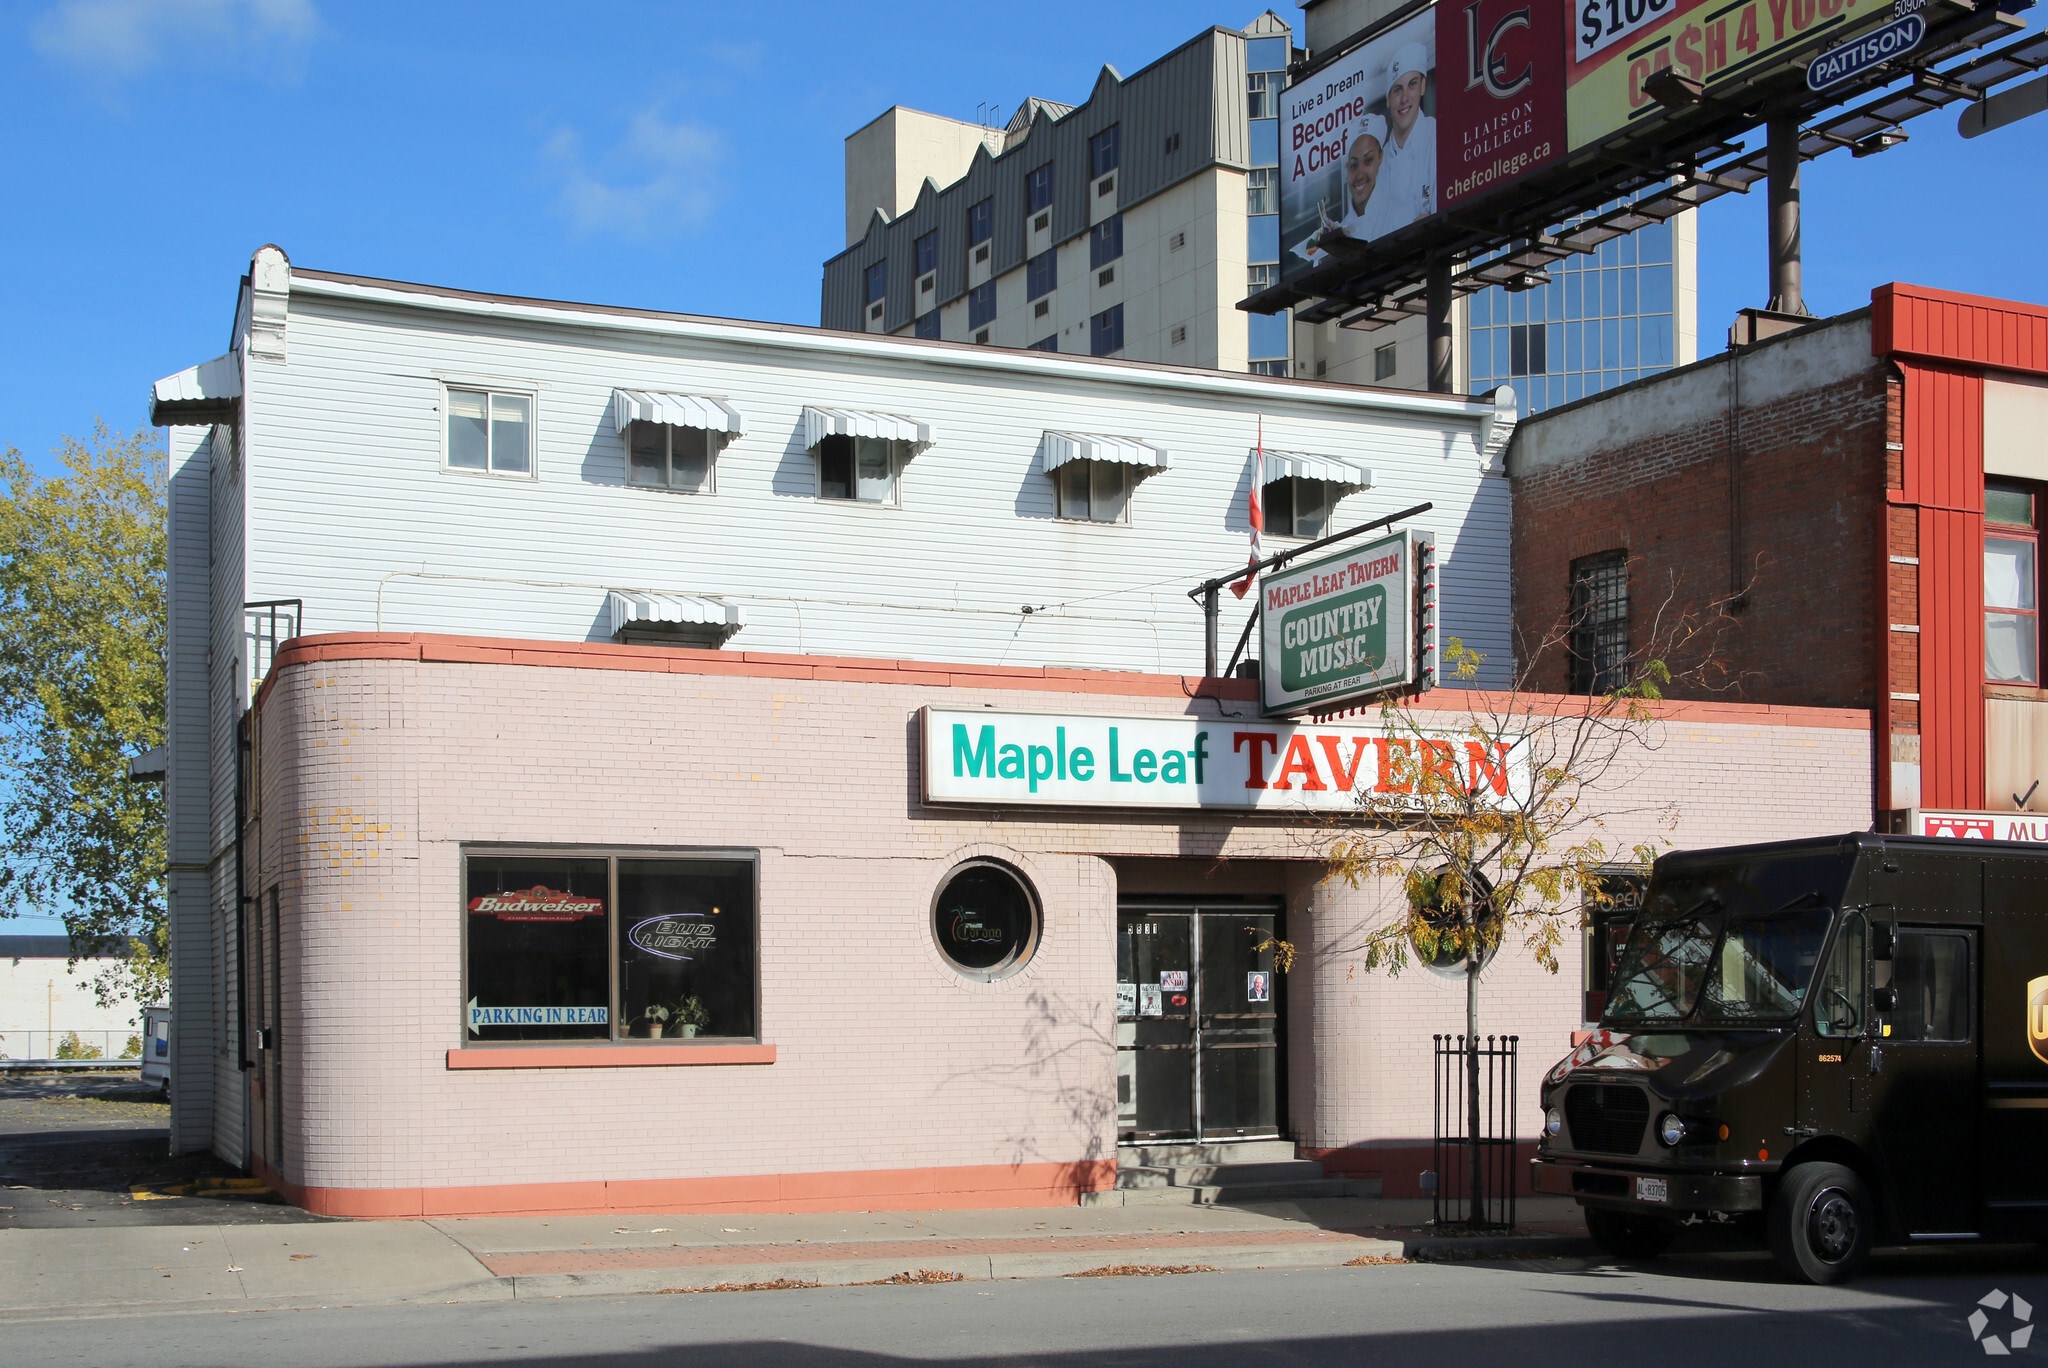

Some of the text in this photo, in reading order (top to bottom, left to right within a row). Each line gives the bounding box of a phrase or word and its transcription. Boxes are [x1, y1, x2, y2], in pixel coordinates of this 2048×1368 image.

[1736, 3, 1759, 54] 4
[1895, 0, 1927, 17] 5090A
[1815, 23, 1914, 83] PATTISON
[1292, 70, 1364, 120] Live a Dream
[1292, 96, 1365, 151] Become
[1463, 100, 1534, 145] LIAISON
[1463, 119, 1532, 162] COLLEGE
[1292, 128, 1348, 182] A Chef
[1446, 142, 1551, 200] chefcollege.ca
[1268, 553, 1399, 611] MAPLE LEAF TAVERN
[1284, 595, 1383, 650] COUNTRY
[1299, 634, 1367, 678] MUSIC
[1304, 676, 1361, 697] PARKING AT REAR
[952, 723, 1511, 797] Maple Leaf TAVERN
[474, 897, 602, 912] Budweiser
[1600, 892, 1644, 912] OPEN
[640, 933, 717, 948] LIGHT
[655, 921, 715, 936] BUD
[472, 1008, 607, 1024] PARKING IN REAR
[1818, 1054, 1842, 1062] 862574
